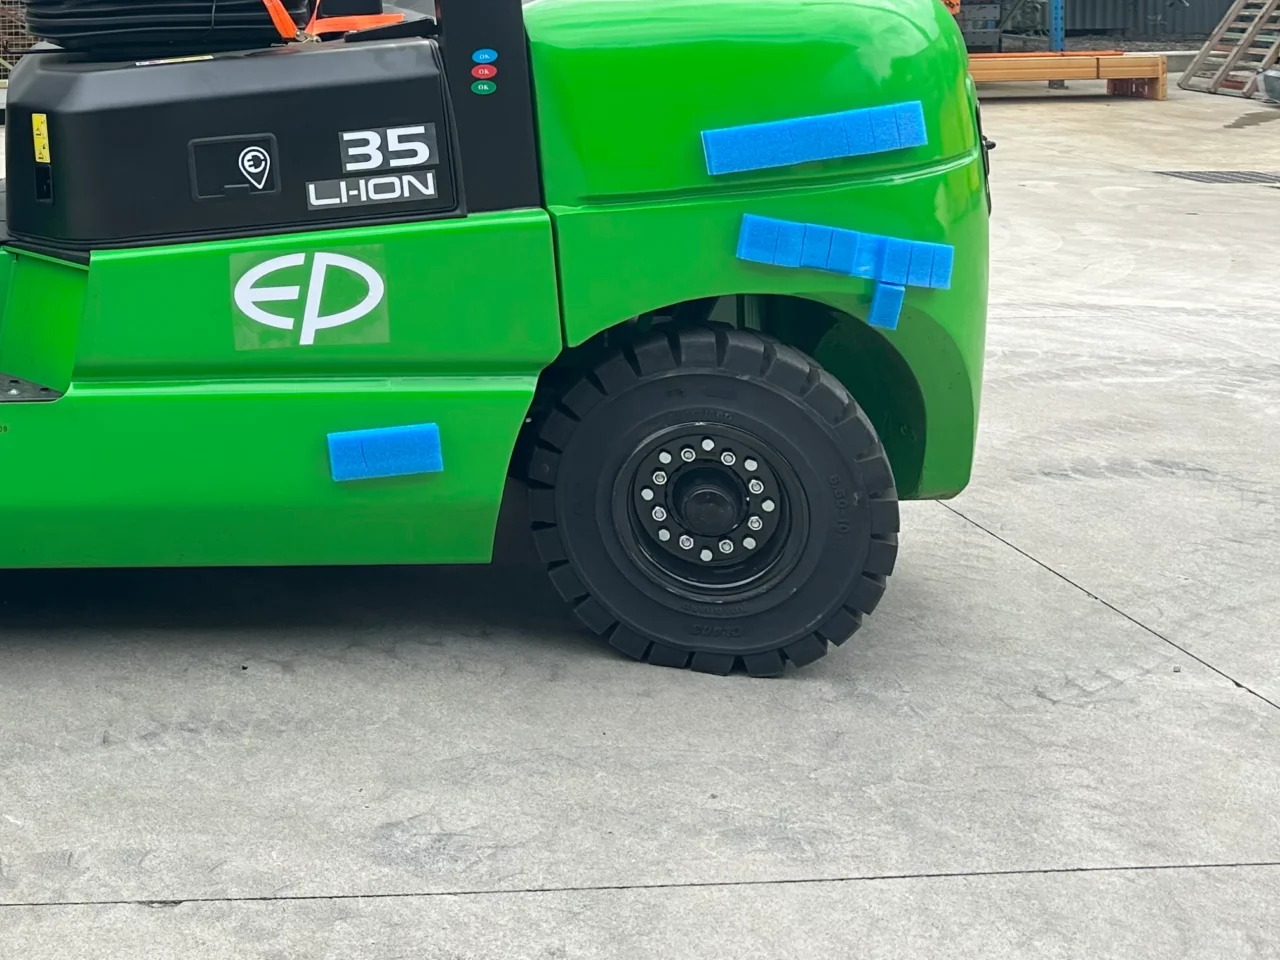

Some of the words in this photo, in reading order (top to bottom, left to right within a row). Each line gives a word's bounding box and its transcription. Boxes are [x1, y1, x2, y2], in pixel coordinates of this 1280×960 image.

[342, 126, 430, 170] 35
[308, 172, 435, 207] LI-ION
[234, 251, 385, 345] EP
